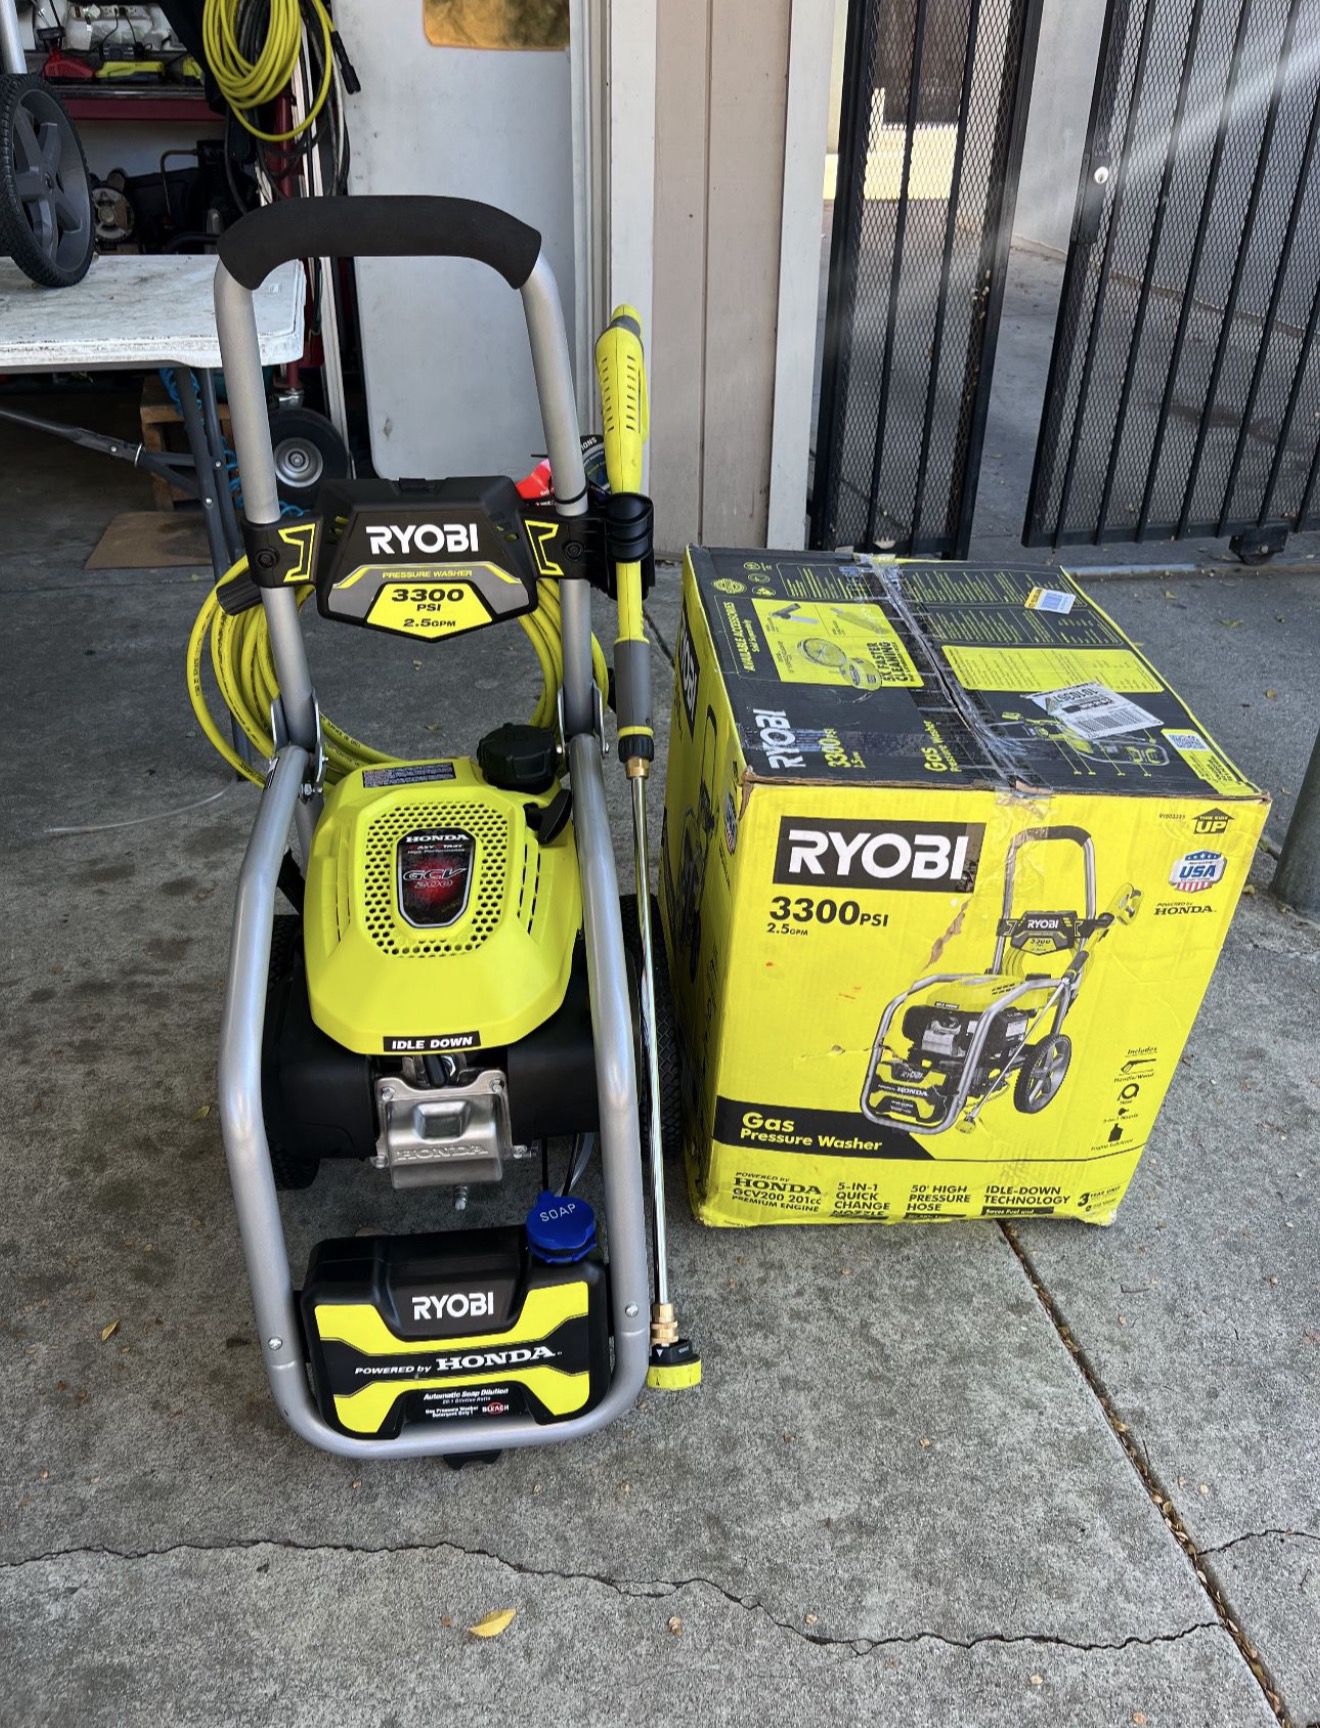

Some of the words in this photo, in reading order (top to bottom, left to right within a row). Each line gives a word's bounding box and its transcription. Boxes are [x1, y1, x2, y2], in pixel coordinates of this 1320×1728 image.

[366, 523, 479, 554] RYOBI
[382, 570, 431, 579] PRESSURE
[434, 569, 473, 577] WASHER
[392, 588, 464, 602] 3300
[416, 603, 441, 612] PSI
[403, 618, 456, 628] 2.5GPM
[878, 642, 908, 681] CLEANING
[753, 708, 806, 769] RYOBI
[922, 747, 948, 772] Gas
[1195, 821, 1227, 833] UP
[405, 834, 470, 843] HONDA
[788, 829, 969, 880] RYOBI
[1179, 865, 1217, 879] USA
[769, 896, 889, 927] 3300PSI
[1153, 905, 1213, 915] HONDA
[1027, 919, 1059, 929] RYOBI
[392, 1039, 425, 1050] IDLE
[430, 1036, 473, 1048] DOWN
[1127, 1046, 1158, 1055] Includes
[896, 1087, 928, 1097] HONDA
[742, 1112, 795, 1133] Gas
[740, 1128, 814, 1147] Pressure
[817, 1135, 884, 1151] Washer
[394, 1145, 489, 1161] HONDA
[733, 1177, 822, 1195] HONDA
[837, 1182, 878, 1191] 5-IN-1
[932, 1184, 968, 1194] HIGH
[985, 1185, 1062, 1195] IDLE-DOWN
[733, 1188, 785, 1201] GCV200
[835, 1191, 878, 1201] QUICK
[909, 1193, 971, 1203] PRESSURE
[984, 1195, 1071, 1206] TECHNOLOGY
[1077, 1192, 1091, 1207] 3
[732, 1195, 778, 1208] PREMIUM
[780, 1202, 820, 1213] ENGINE
[834, 1200, 891, 1211] CHANGE
[906, 1203, 942, 1212] HOSE
[539, 1203, 577, 1222] SOAP
[411, 1291, 494, 1321] RYOBI
[355, 1366, 415, 1375] POWERED
[416, 1364, 432, 1375] by
[436, 1345, 556, 1371] HONDA
